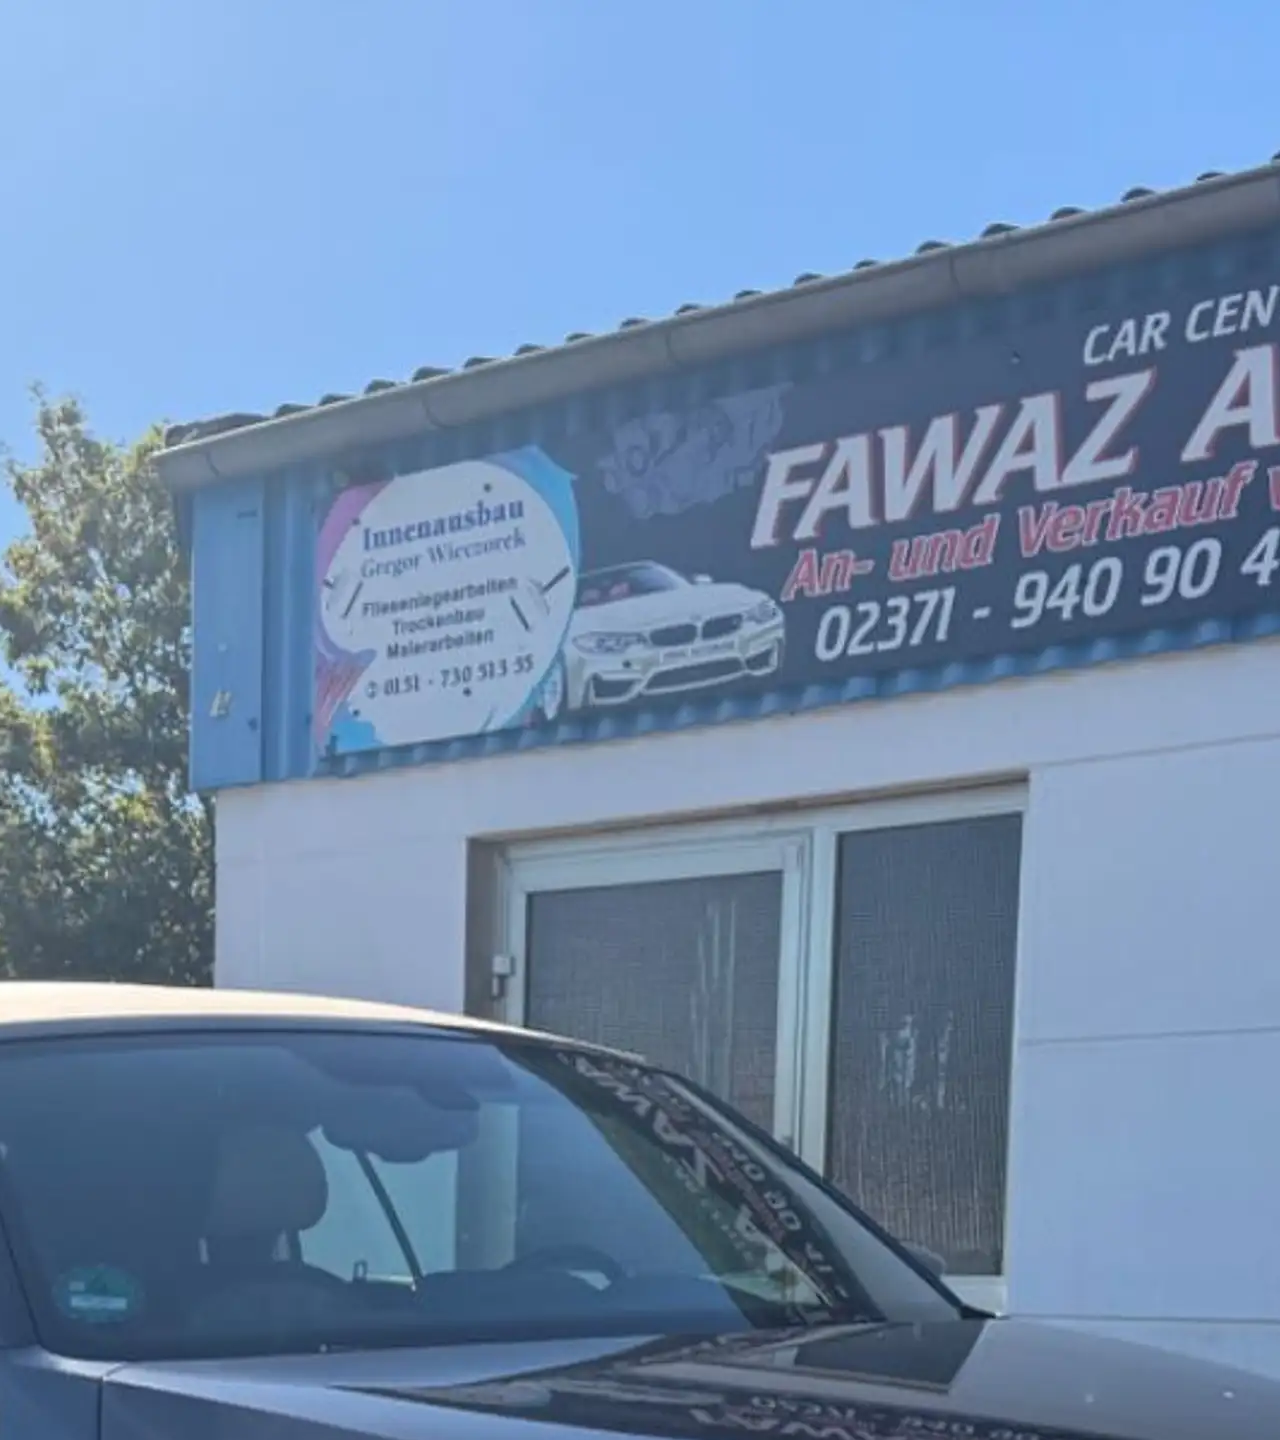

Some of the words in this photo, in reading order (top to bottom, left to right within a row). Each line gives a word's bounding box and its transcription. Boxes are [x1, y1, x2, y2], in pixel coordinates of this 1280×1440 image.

[1084, 325, 1169, 366] CAR
[751, 366, 1157, 549] FAWAZ
[361, 500, 525, 552] Innenausbau
[781, 549, 874, 602] An-
[889, 514, 999, 583] und
[1019, 460, 1260, 558] Verkauf
[360, 552, 422, 579] Gregor
[426, 527, 527, 564] Wieczorek
[392, 608, 486, 636] Trockenbau
[815, 586, 957, 662] 02371
[1011, 557, 1121, 630] 940
[1141, 536, 1221, 605] 90
[386, 628, 495, 660] Malerarbeiten
[382, 674, 420, 696] 0151
[439, 667, 472, 689] 730
[477, 659, 508, 680] 513
[512, 653, 535, 673] 55
